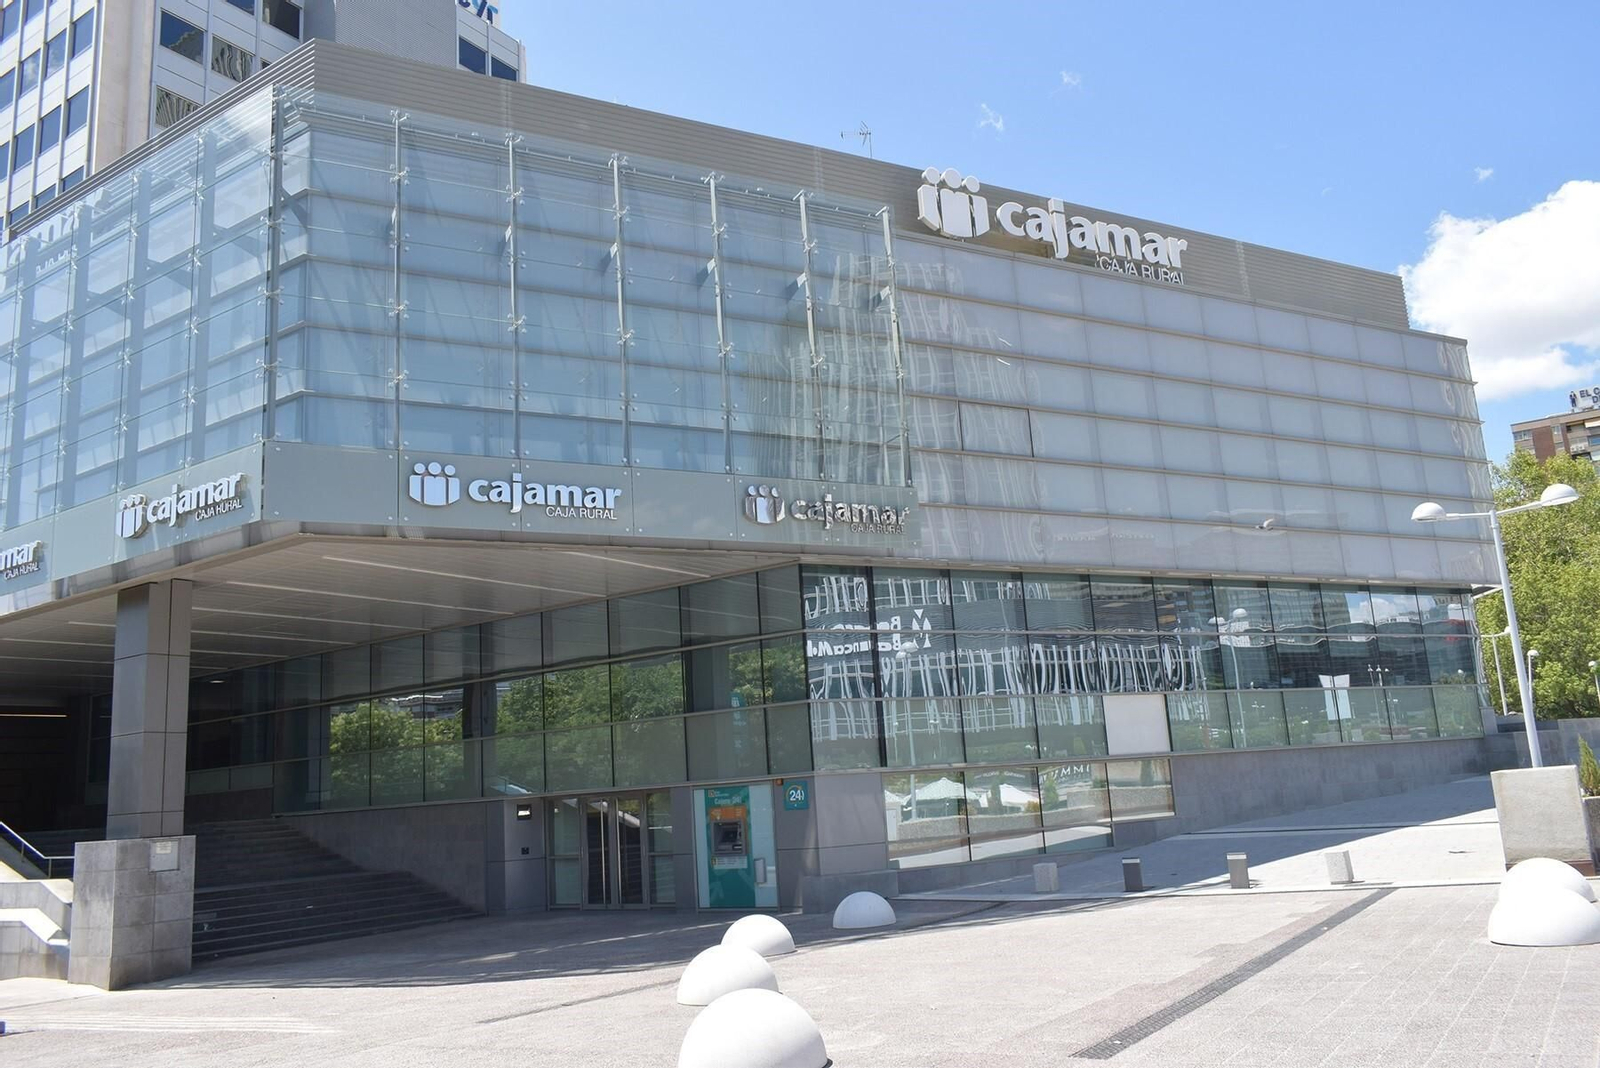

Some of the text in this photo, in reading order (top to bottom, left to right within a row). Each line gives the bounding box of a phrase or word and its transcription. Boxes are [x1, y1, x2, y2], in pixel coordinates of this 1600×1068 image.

[996, 198, 1188, 268] cajamar
[1099, 256, 1184, 285] CAJA RURAL
[1579, 390, 1591, 398] EL
[147, 472, 246, 527] cajamar
[468, 472, 622, 513] cajamar
[195, 498, 243, 521] CAJA RURAL
[546, 506, 618, 520] CAJA RURAL
[790, 493, 911, 530] cajamar
[851, 522, 904, 535] CAJA RURAL
